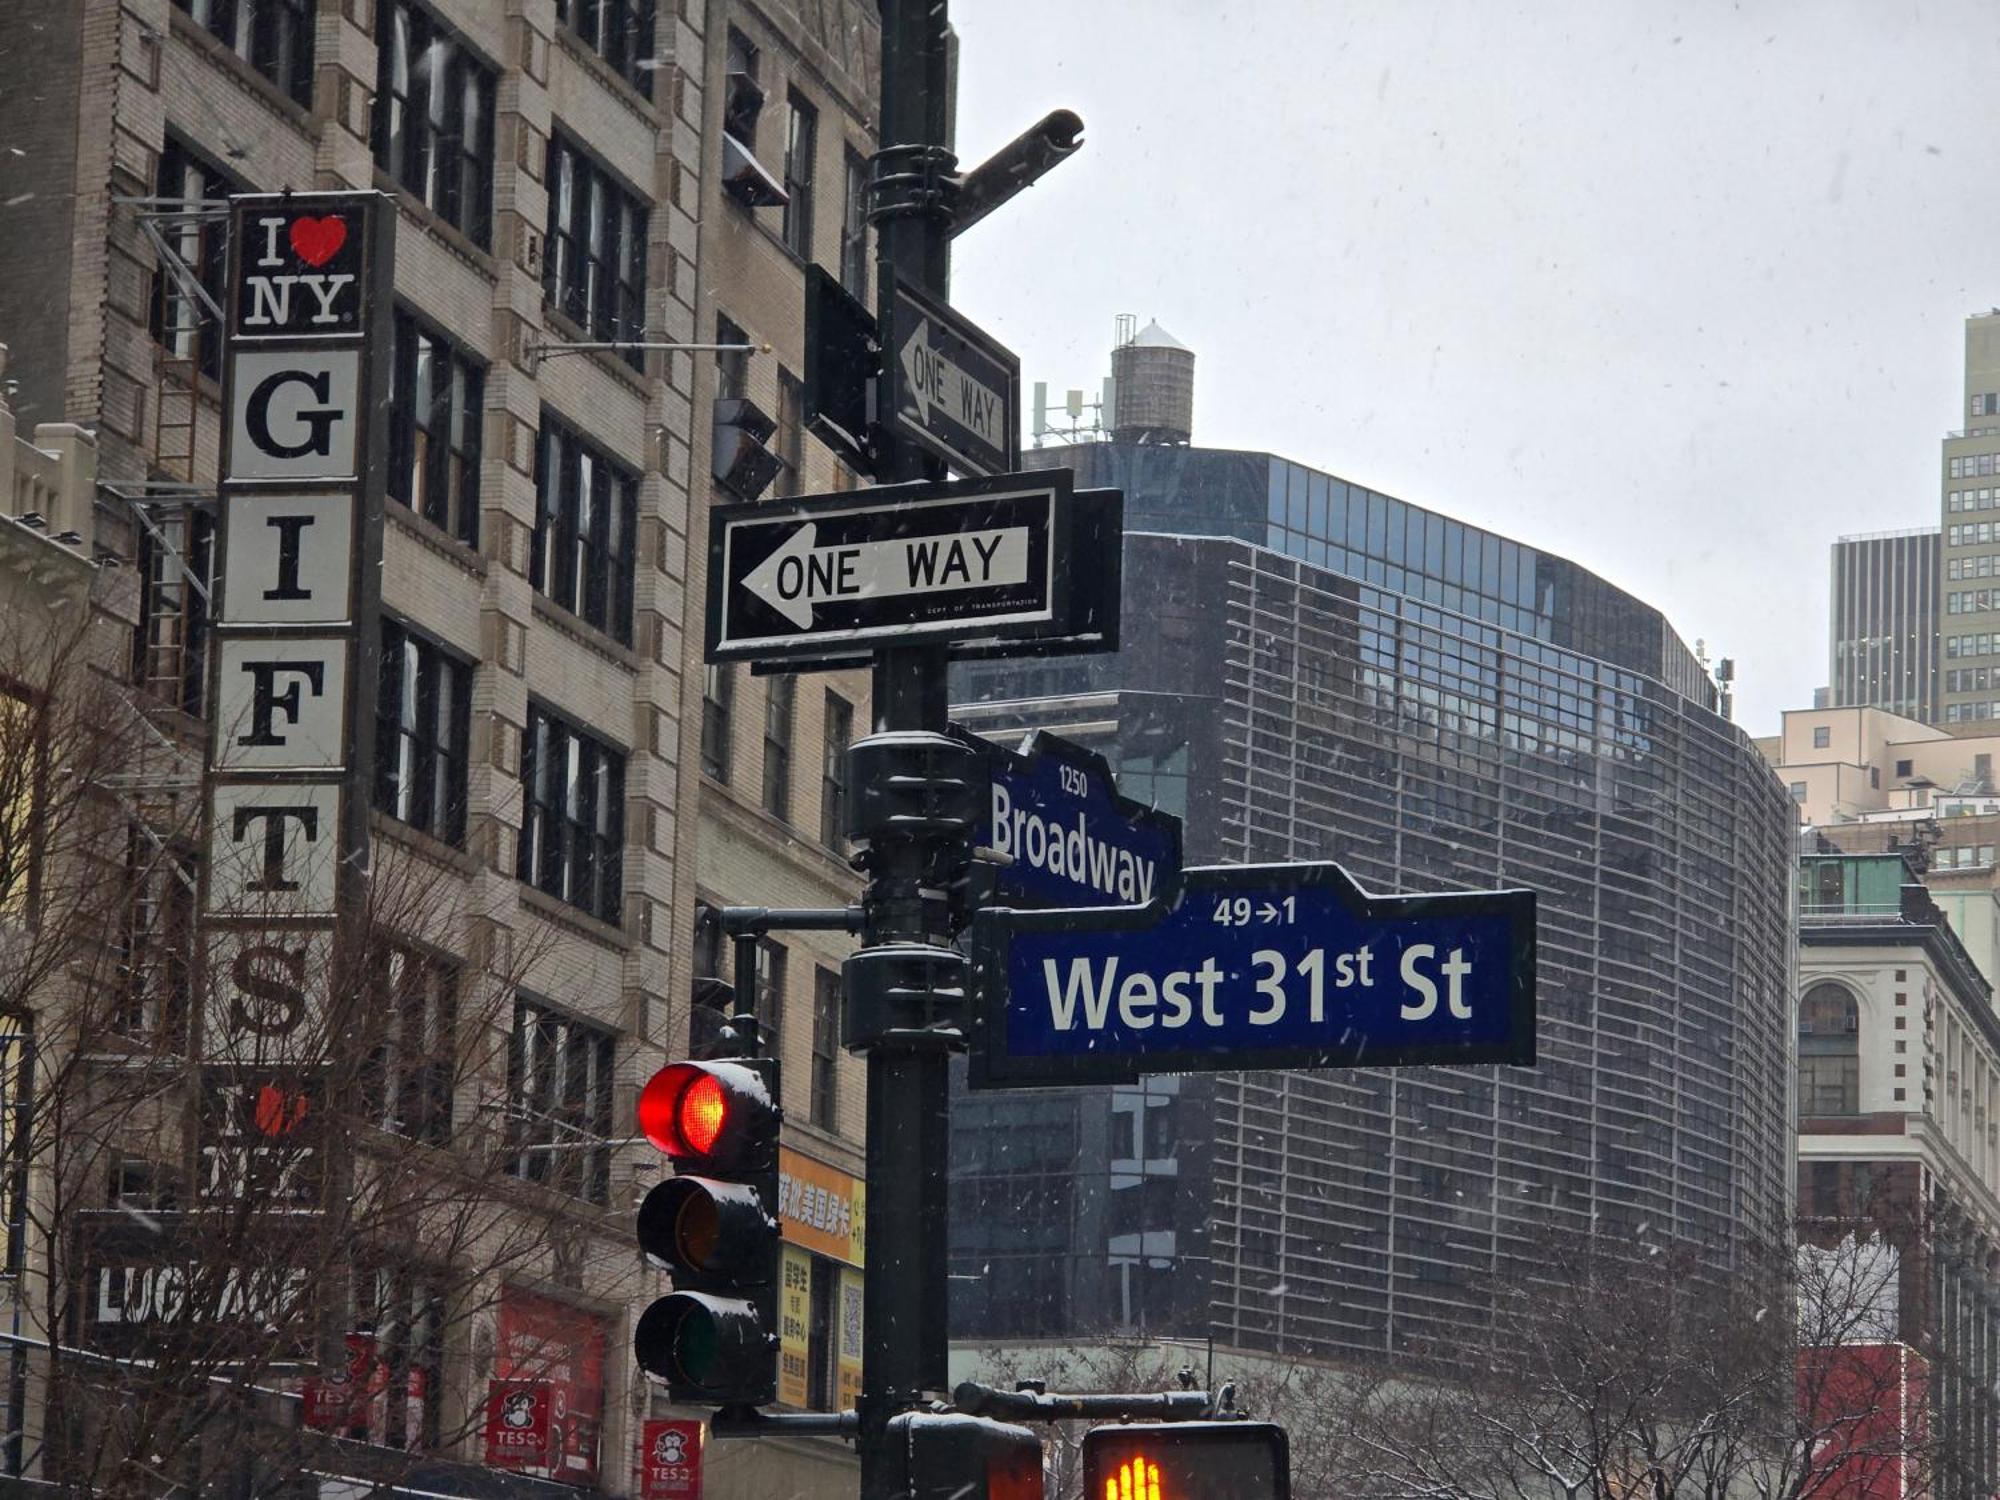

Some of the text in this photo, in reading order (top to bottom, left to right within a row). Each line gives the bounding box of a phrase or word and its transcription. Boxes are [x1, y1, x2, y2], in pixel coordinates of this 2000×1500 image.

[258, 217, 286, 267] I
[244, 273, 355, 325] NY
[914, 344, 994, 438] ONE WAY
[776, 534, 1003, 601] ONE WAY
[230, 369, 344, 1037] GIFTS
[1058, 764, 1088, 798] 1250
[991, 782, 1155, 902] Broadway
[1043, 943, 1473, 1031] West 31st St
